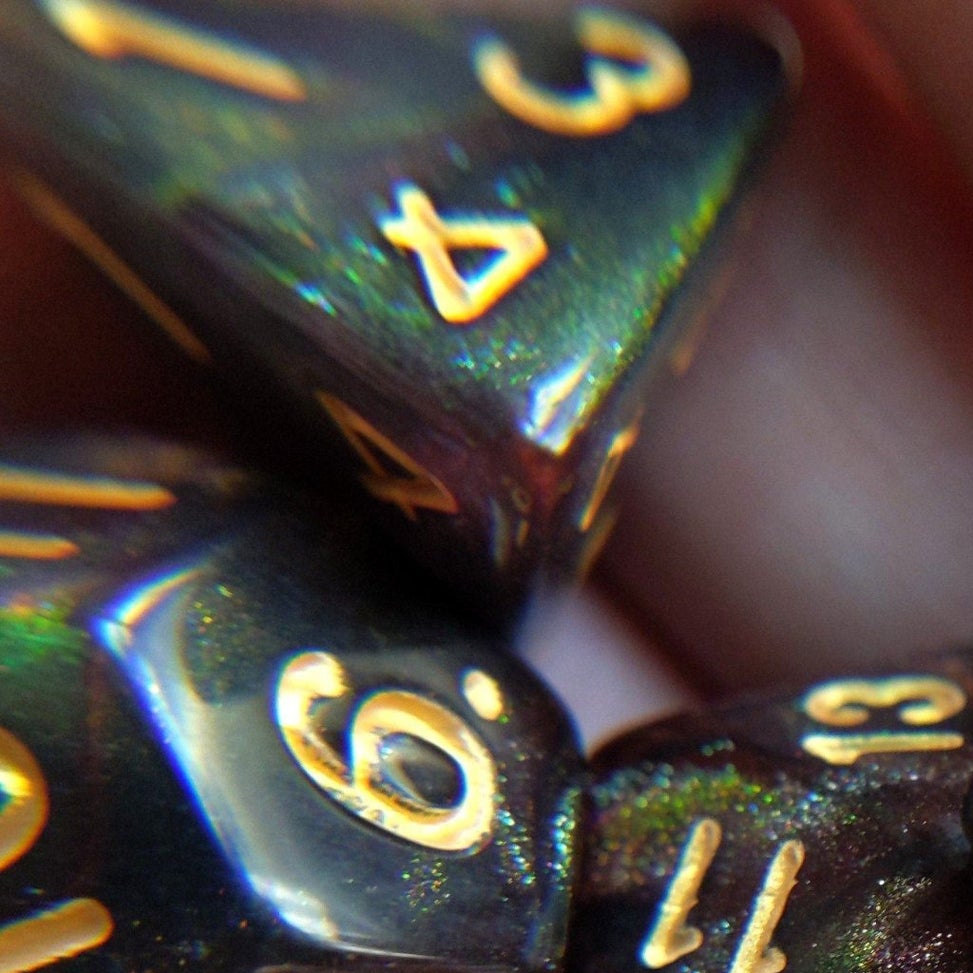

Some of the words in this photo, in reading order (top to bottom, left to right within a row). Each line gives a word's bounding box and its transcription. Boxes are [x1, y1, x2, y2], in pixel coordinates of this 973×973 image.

[472, 6, 693, 136] 3
[376, 178, 550, 325] 4
[802, 674, 968, 765] 13
